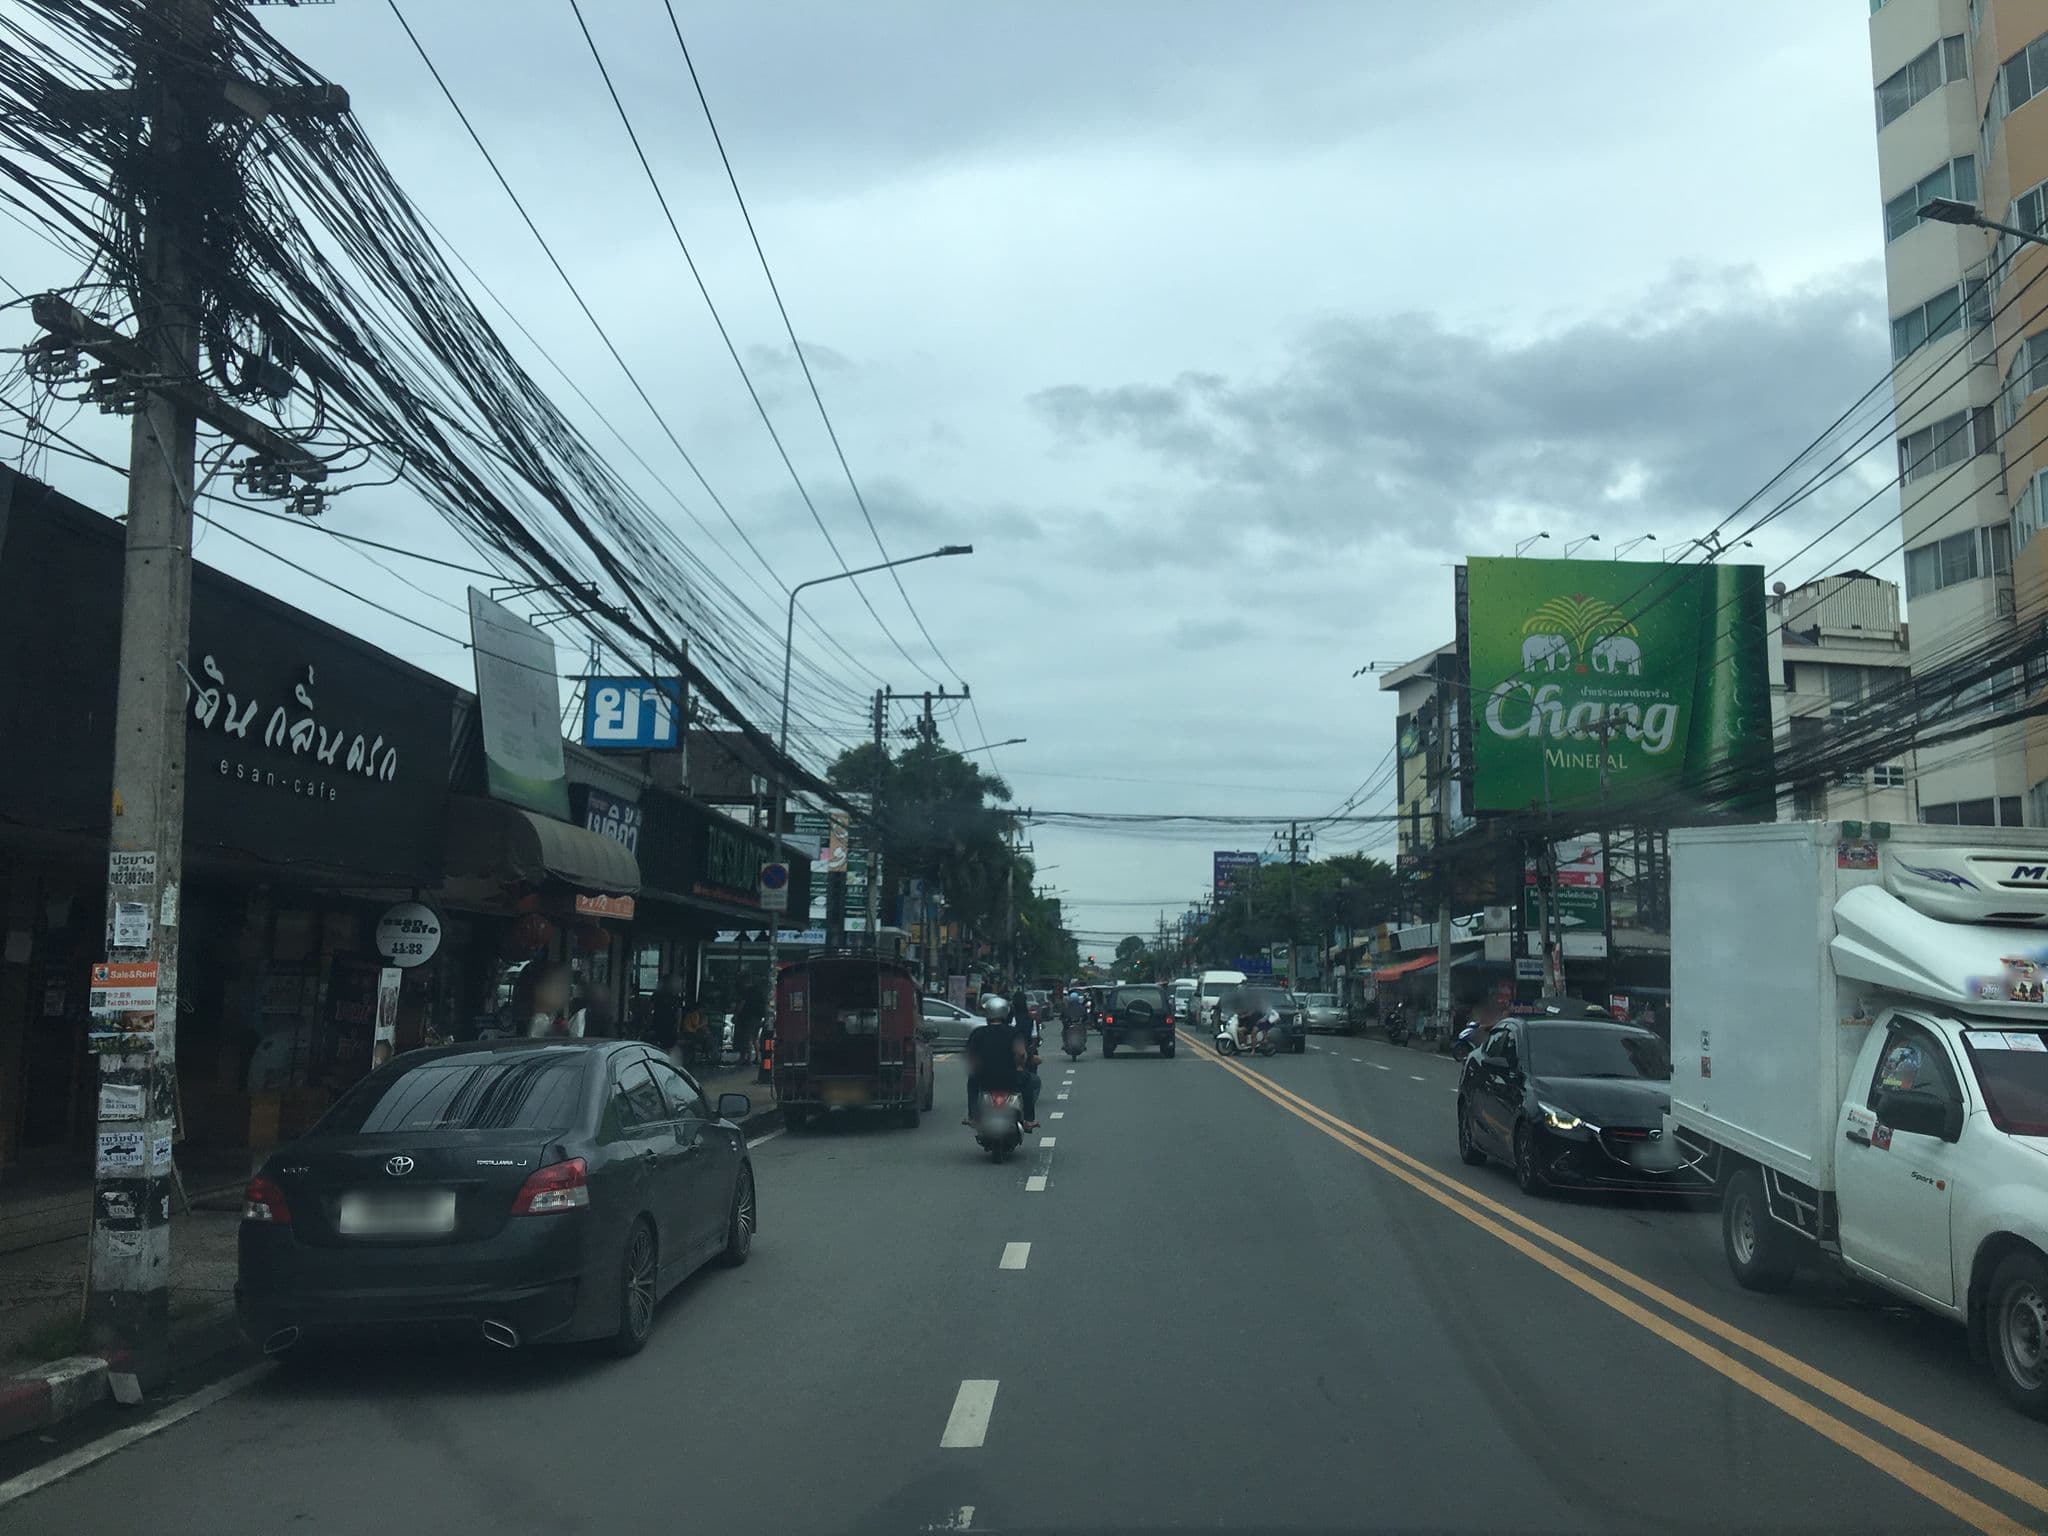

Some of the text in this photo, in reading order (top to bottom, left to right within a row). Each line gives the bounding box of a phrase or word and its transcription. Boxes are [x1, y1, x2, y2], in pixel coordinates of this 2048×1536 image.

[593, 687, 673, 740] ยา
[1485, 680, 1678, 752] Chang
[219, 759, 337, 801] esan-cafe
[112, 854, 155, 865] ปะยาง
